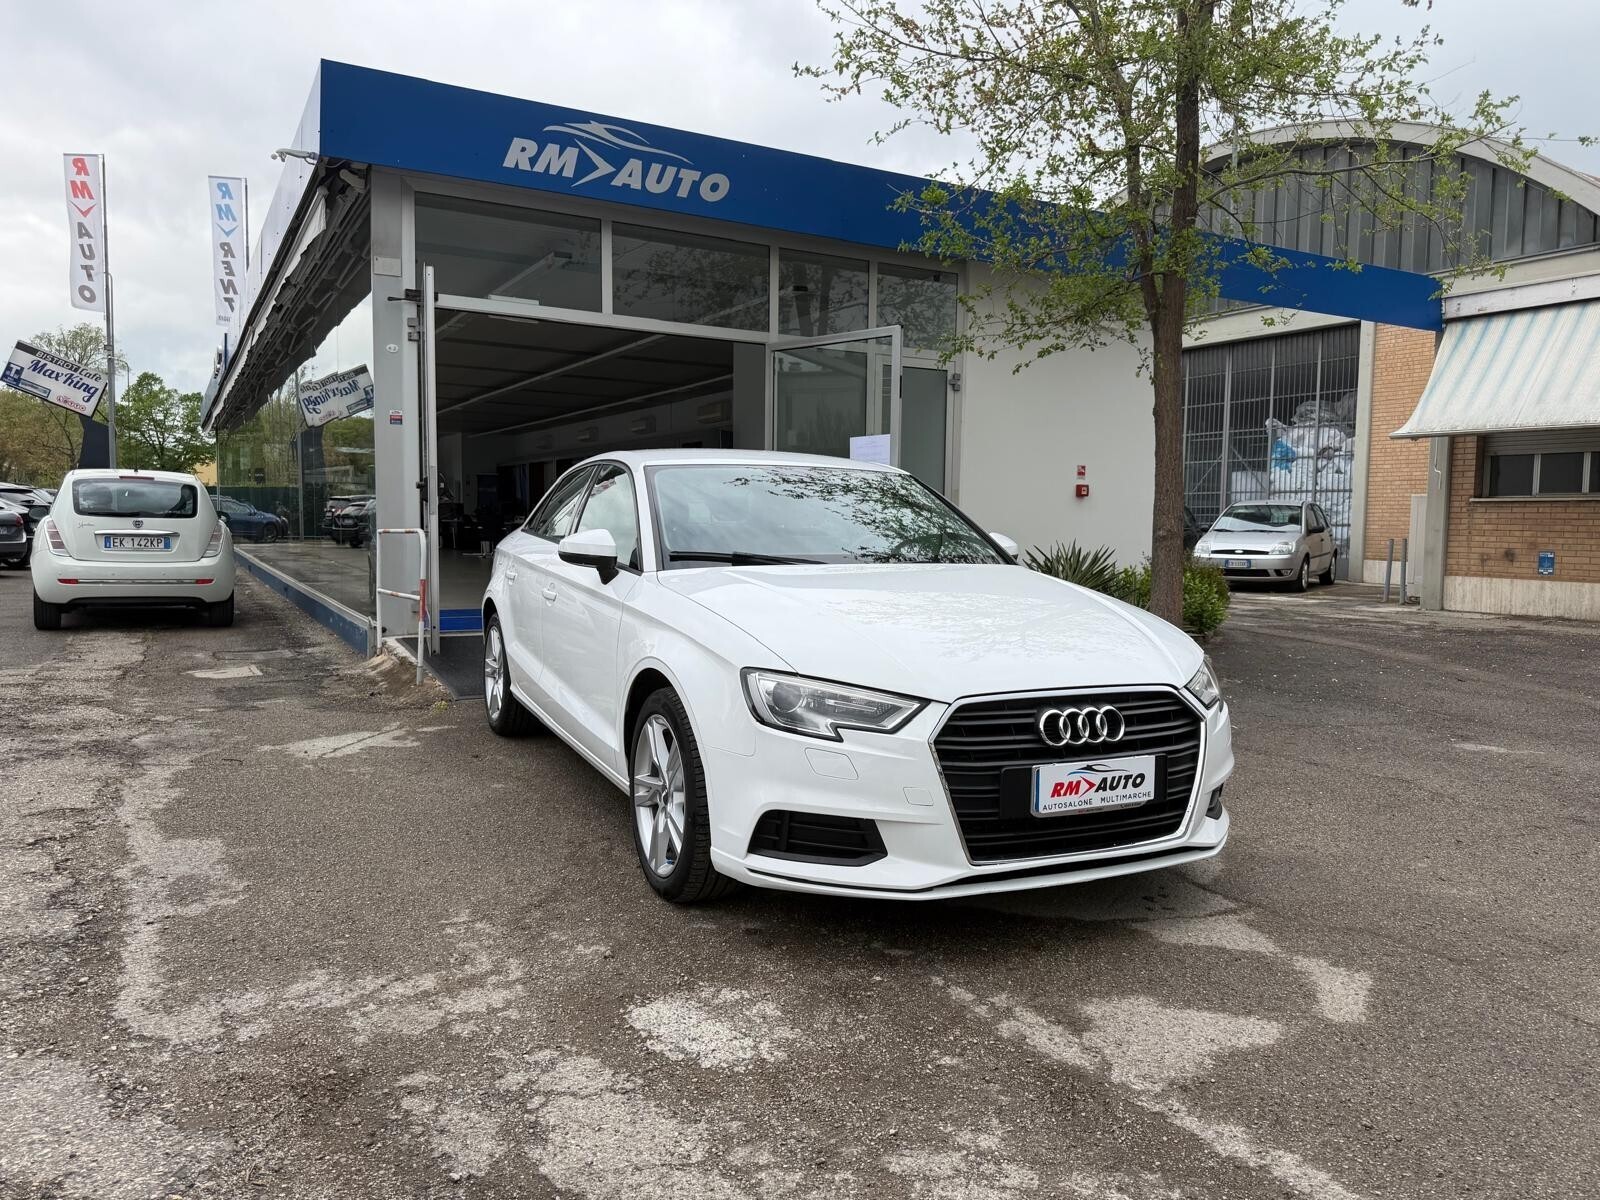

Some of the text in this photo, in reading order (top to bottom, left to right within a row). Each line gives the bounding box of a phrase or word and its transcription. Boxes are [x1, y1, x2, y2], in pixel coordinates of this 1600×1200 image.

[502, 137, 730, 203] RM AUTO
[36, 350, 81, 374] BISTROT
[112, 537, 163, 548] EK 142KP
[1050, 772, 1146, 798] RM AUTO
[1042, 798, 1093, 811] AUTOSALONE
[1100, 790, 1152, 804] MULTIMARCHE
